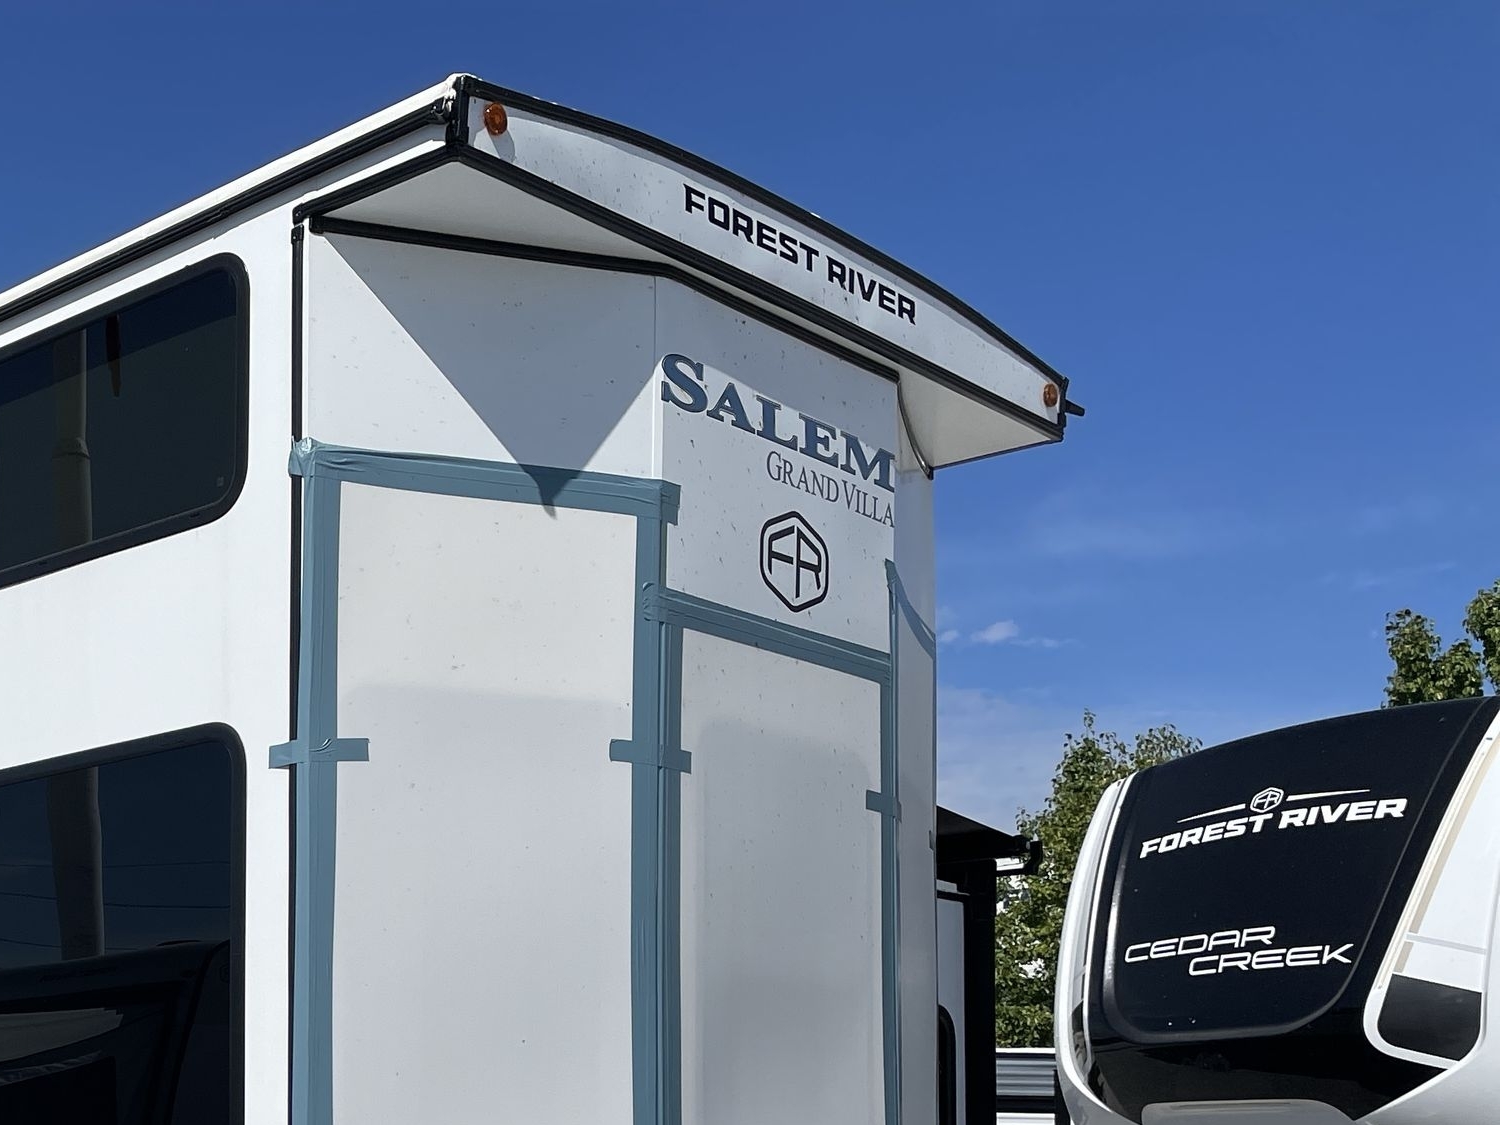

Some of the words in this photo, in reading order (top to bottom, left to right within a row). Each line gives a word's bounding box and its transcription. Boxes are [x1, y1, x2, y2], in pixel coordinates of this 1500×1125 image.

[684, 184, 819, 272] FOREST
[826, 255, 917, 325] RIVER
[661, 353, 896, 493] SALEM
[766, 450, 839, 503] GRAND
[842, 481, 895, 527] VILLA
[1139, 814, 1273, 859] FOREST
[1278, 798, 1408, 829] RIVER
[1124, 925, 1276, 964] CEDAR
[1188, 943, 1355, 977] CREEK
